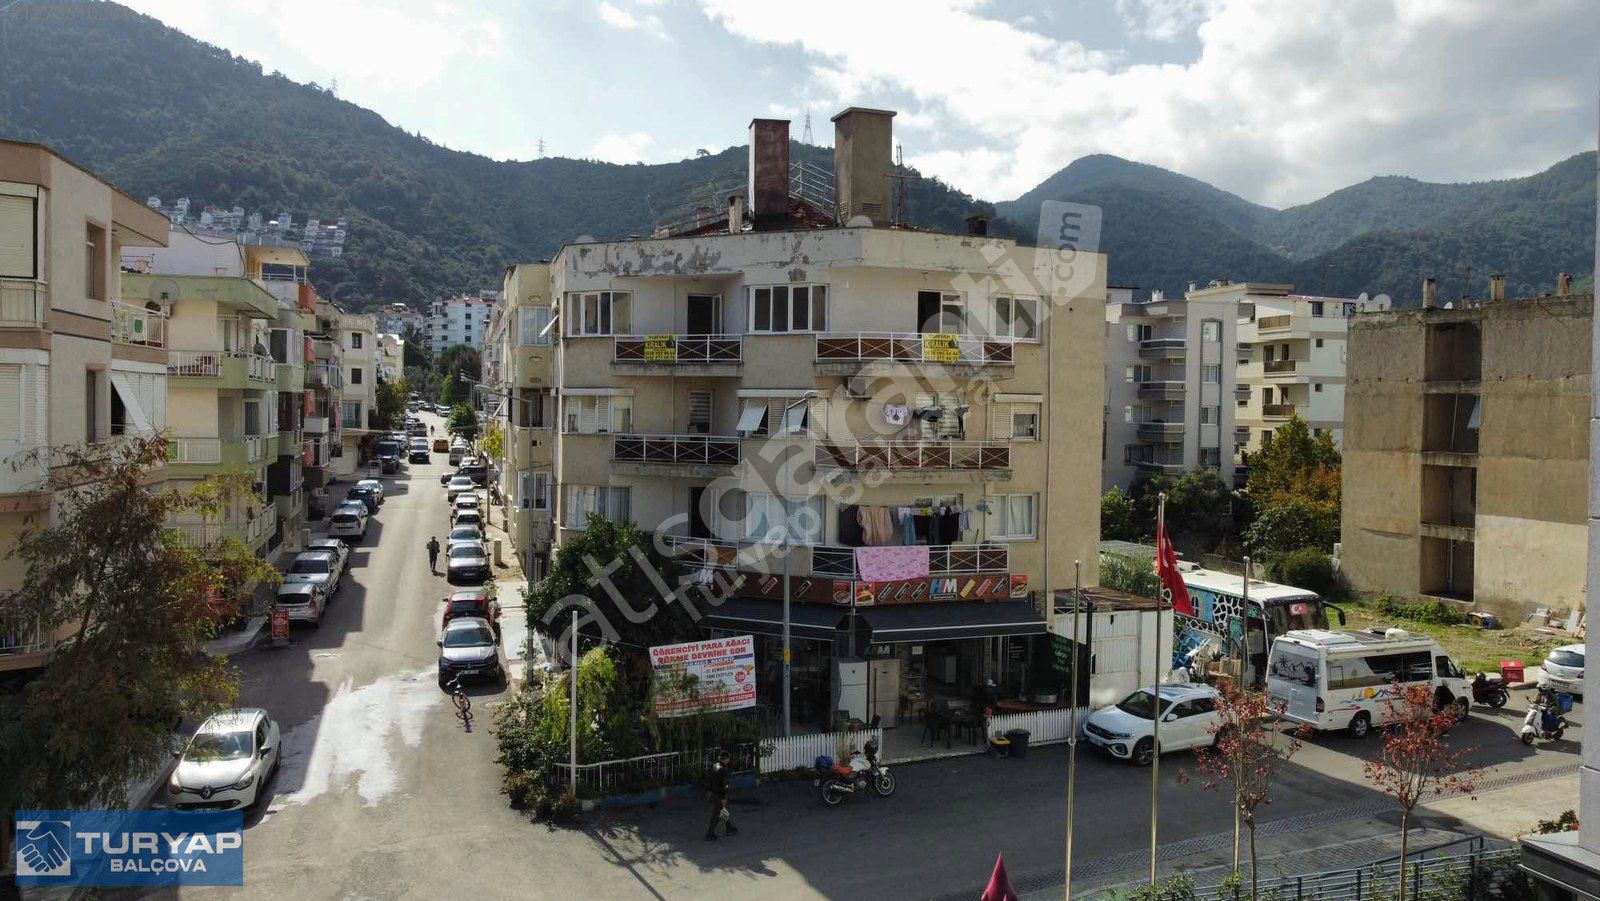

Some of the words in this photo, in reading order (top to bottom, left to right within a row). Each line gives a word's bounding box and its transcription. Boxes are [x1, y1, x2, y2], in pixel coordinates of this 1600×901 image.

[701, 641, 723, 651] PARA
[725, 637, 751, 648] AĞACI
[729, 646, 747, 655] SON
